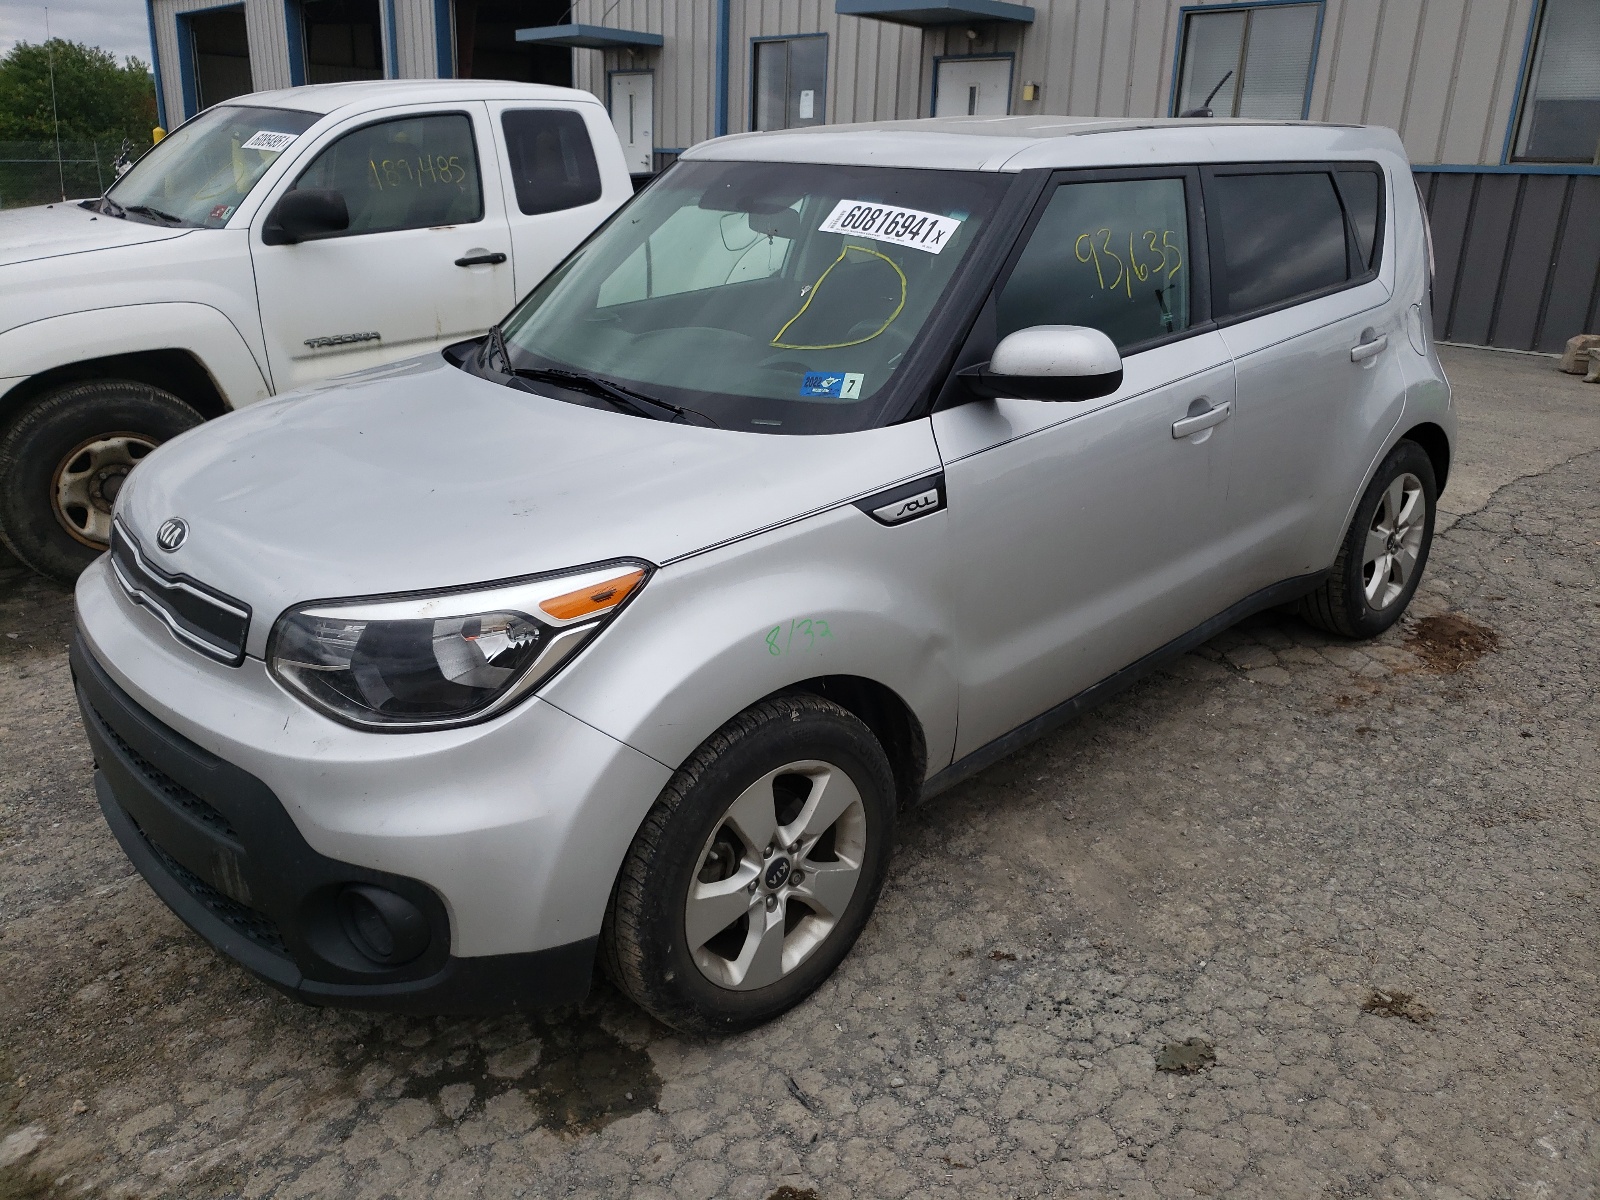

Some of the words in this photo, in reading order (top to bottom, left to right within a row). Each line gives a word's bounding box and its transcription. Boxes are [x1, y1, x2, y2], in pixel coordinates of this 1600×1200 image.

[840, 205, 939, 244] 60816941
[847, 379, 856, 393] 7
[158, 518, 184, 550] KIA
[768, 861, 789, 885] KIA
